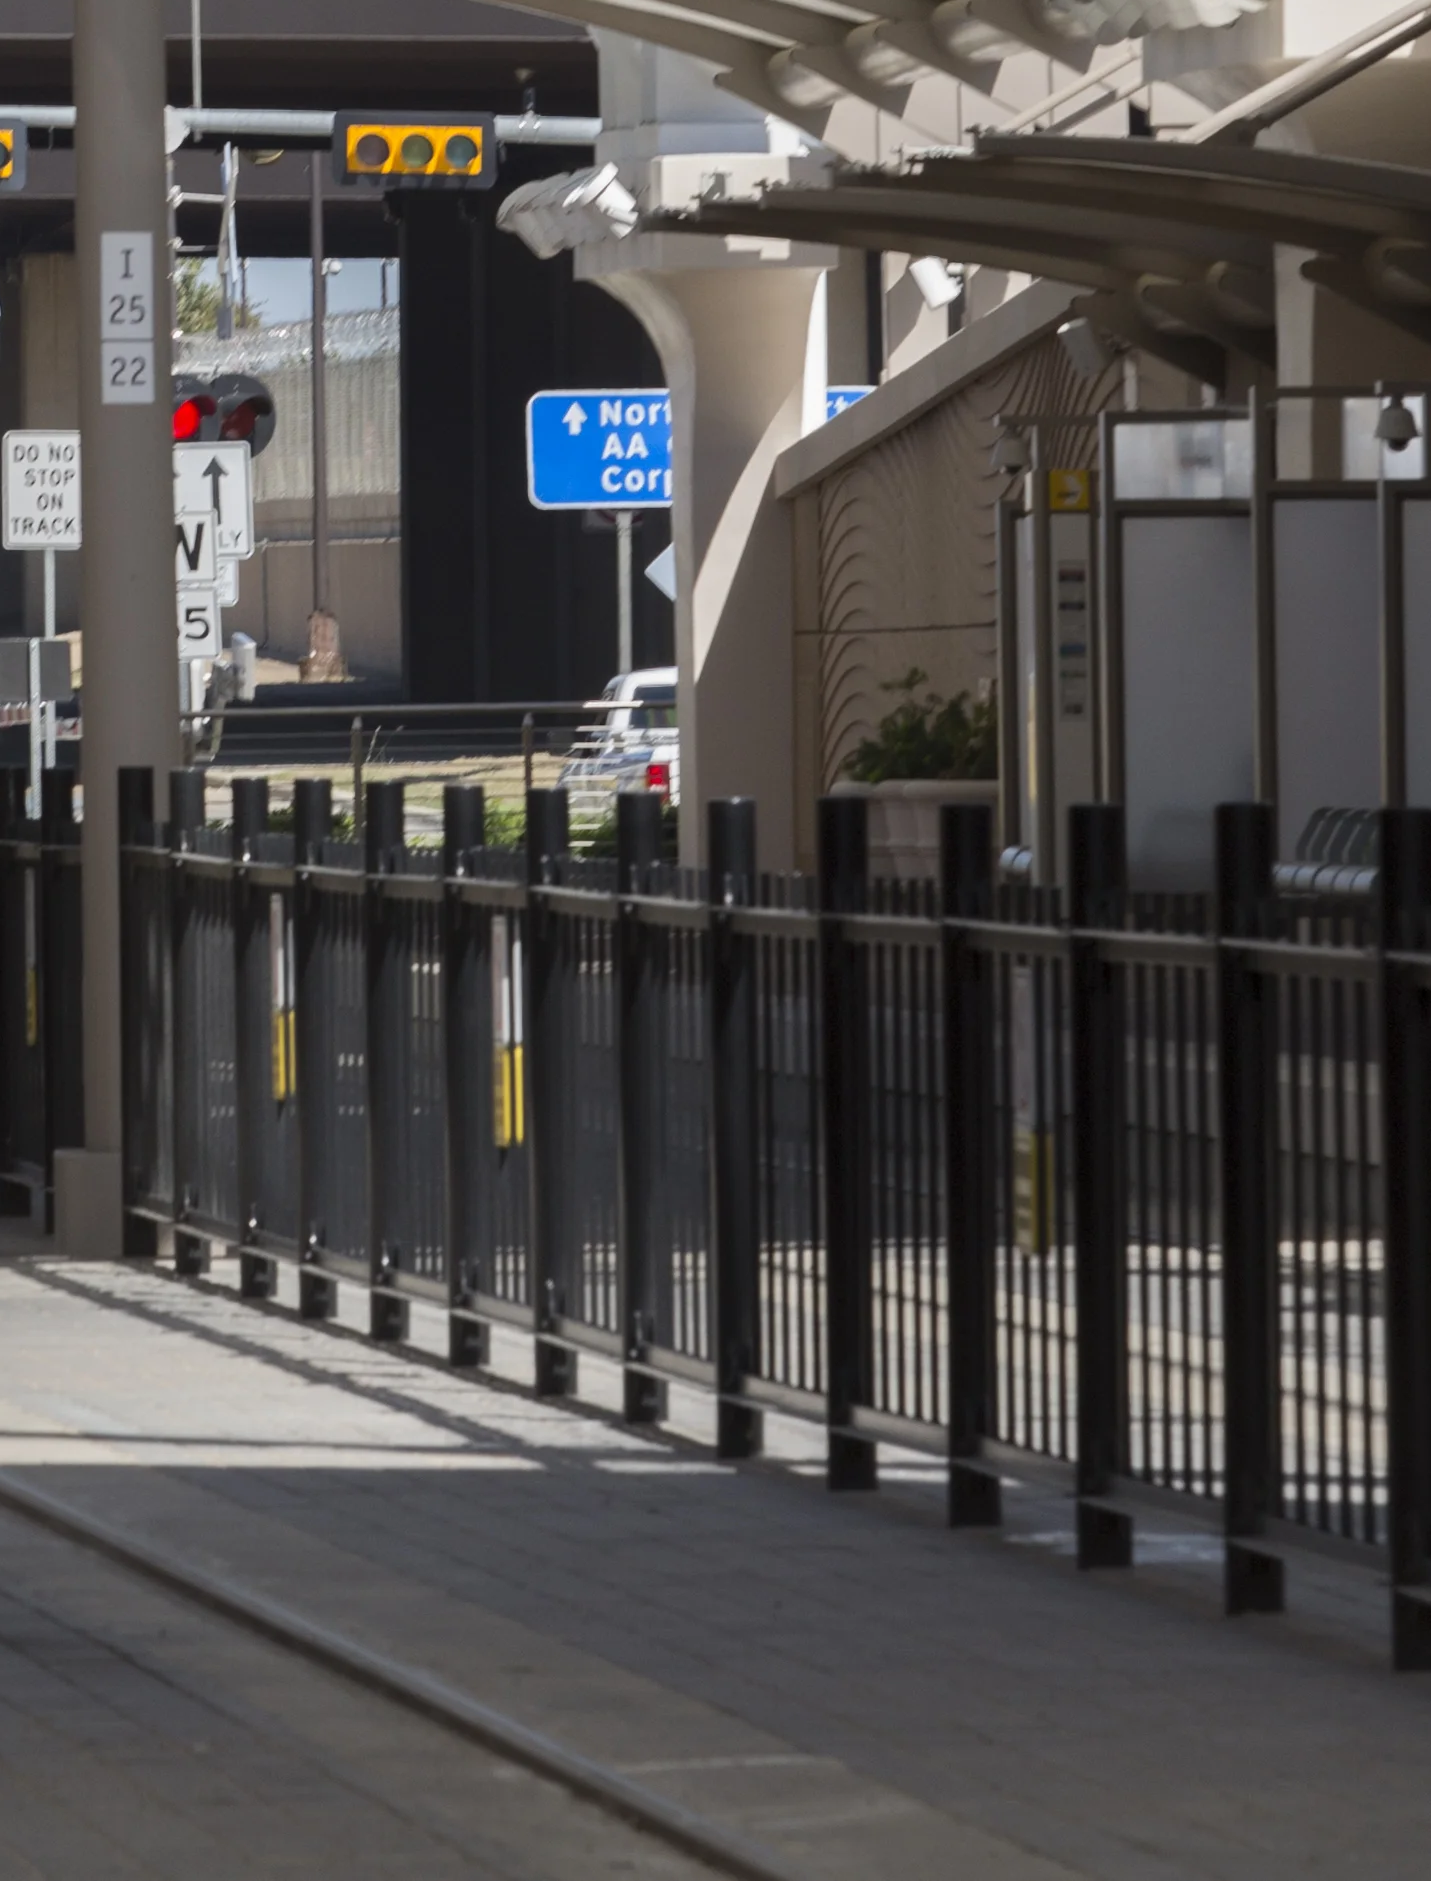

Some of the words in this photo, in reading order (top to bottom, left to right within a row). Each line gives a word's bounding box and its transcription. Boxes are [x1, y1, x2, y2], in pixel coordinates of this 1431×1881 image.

[109, 294, 146, 325] 25
[110, 356, 147, 387] 22
[13, 444, 40, 464] DO
[48, 443, 76, 464] NO
[601, 432, 649, 461] AA
[24, 468, 76, 488] STOP
[36, 492, 64, 512] ON
[11, 516, 76, 536] TRACK
[185, 607, 210, 640] 5
